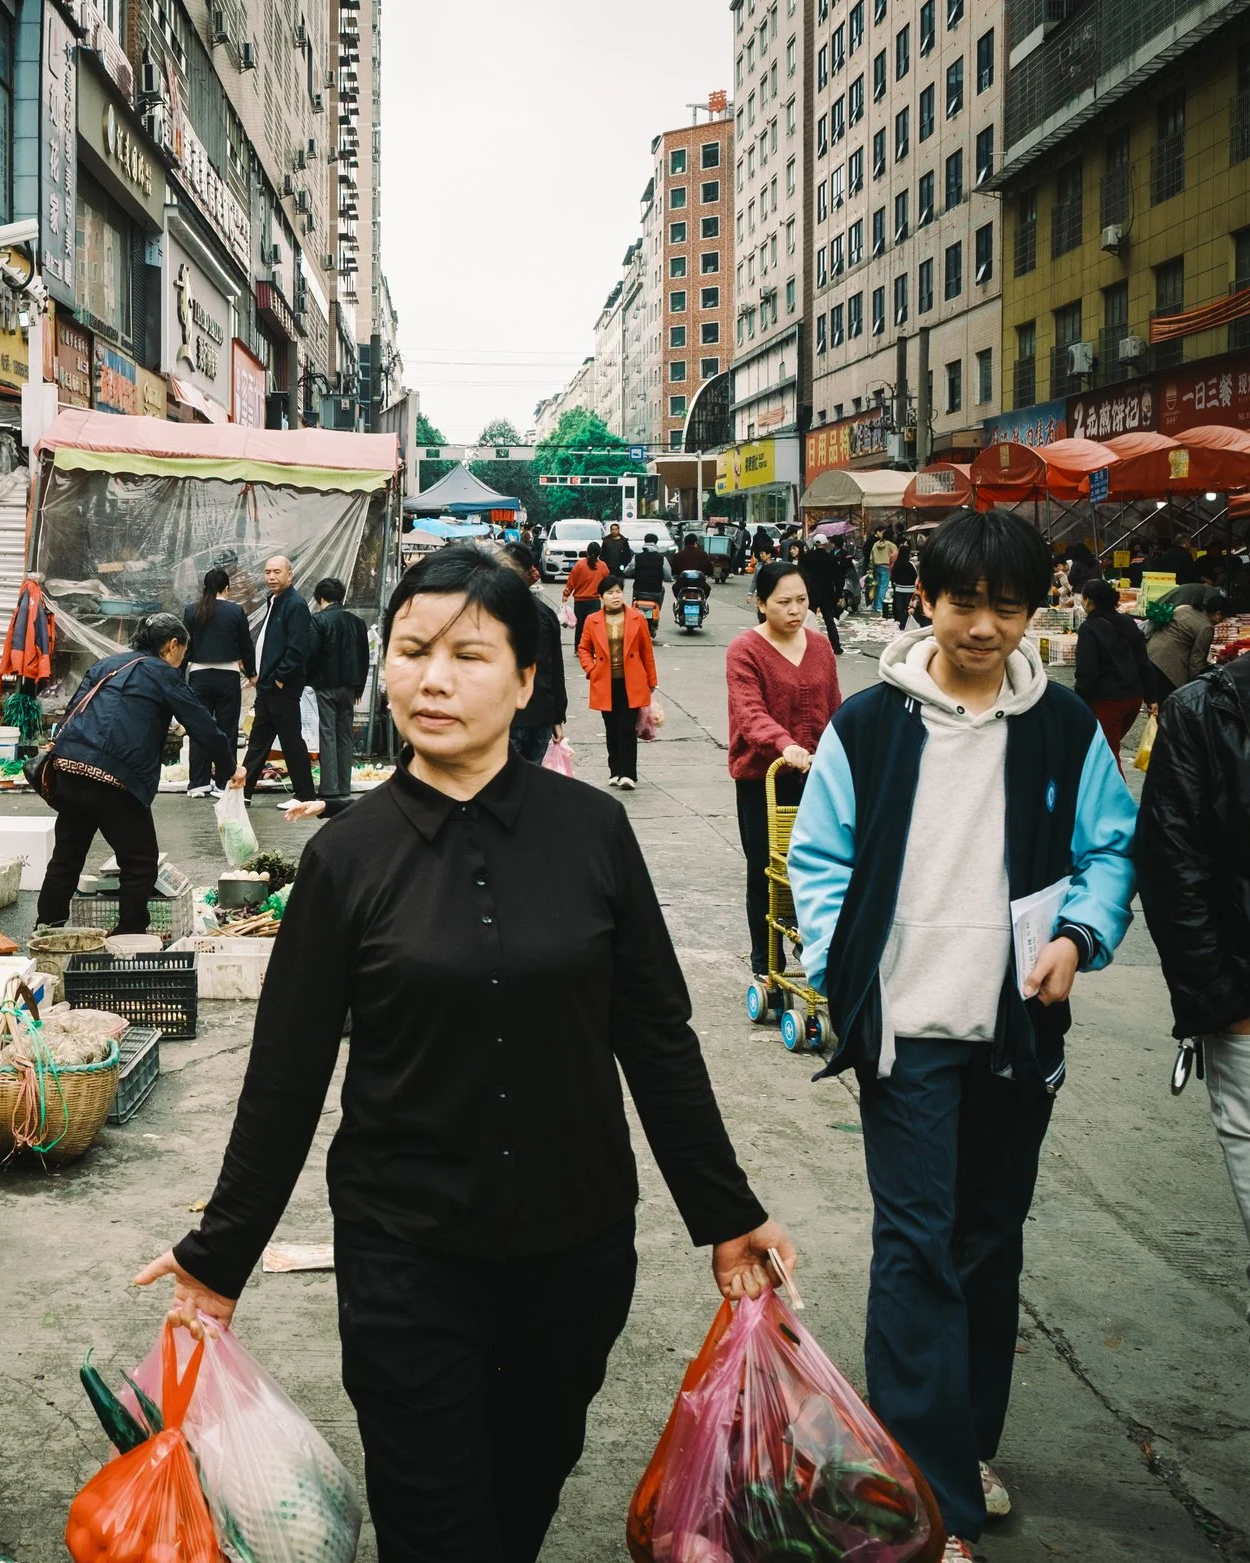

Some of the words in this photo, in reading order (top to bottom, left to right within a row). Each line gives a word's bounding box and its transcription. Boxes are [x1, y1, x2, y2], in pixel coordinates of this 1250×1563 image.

[1182, 373, 1232, 410] 一日三餐
[1073, 397, 1139, 439] 2元煎饼记
